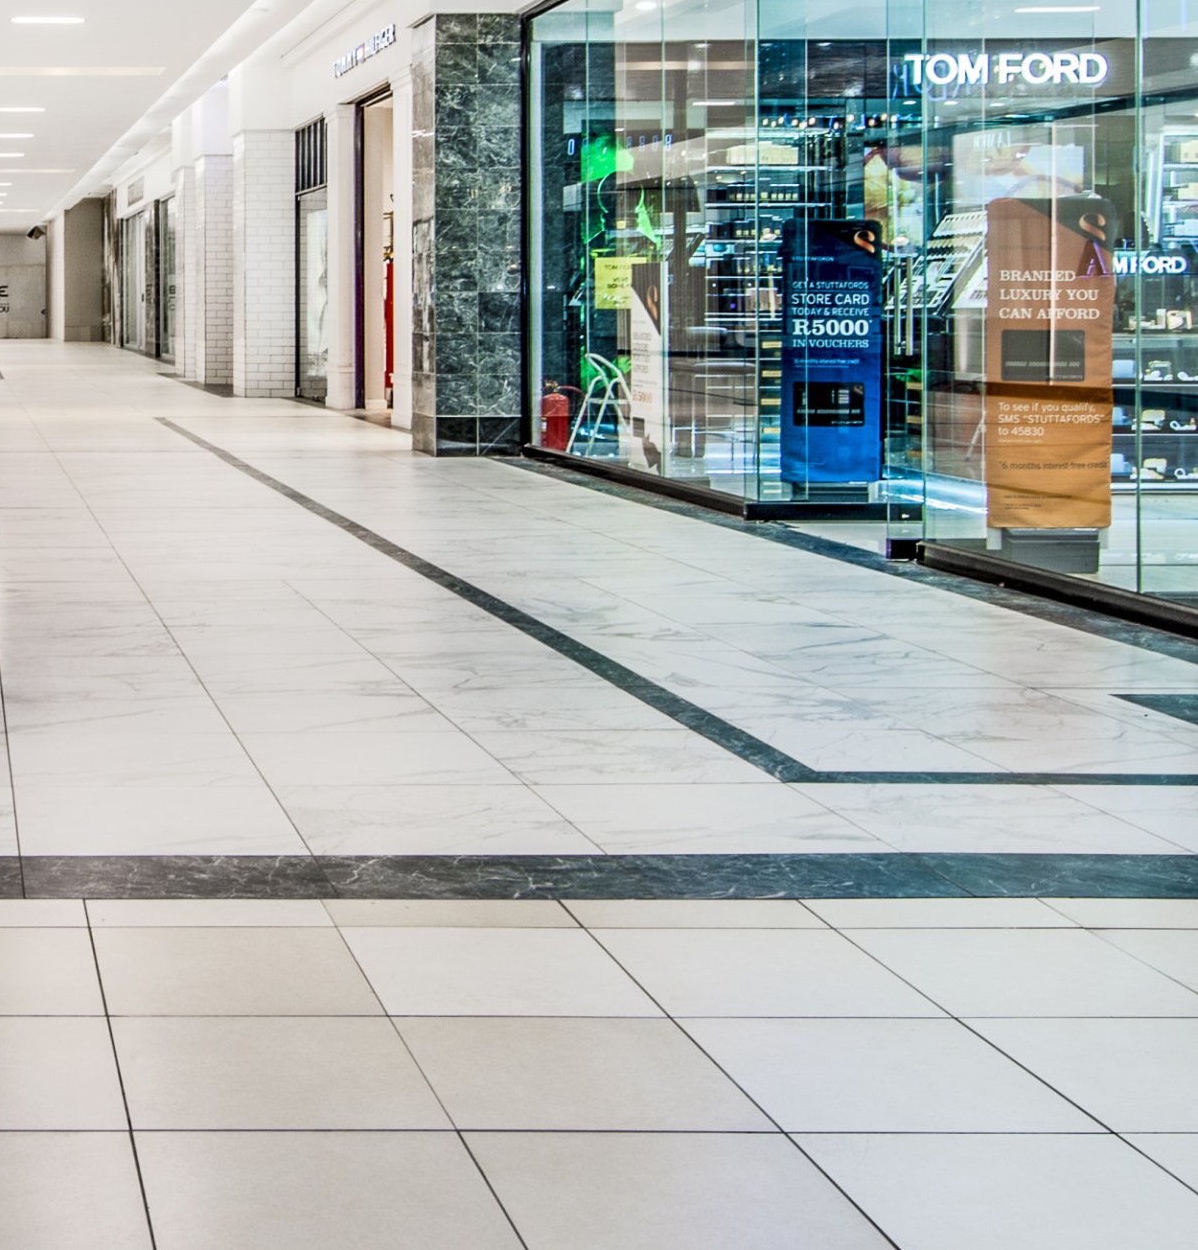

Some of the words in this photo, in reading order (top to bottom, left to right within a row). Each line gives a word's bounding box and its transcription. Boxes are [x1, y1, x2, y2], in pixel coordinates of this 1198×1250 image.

[904, 53, 989, 85] TOM
[999, 53, 1108, 85] FORD
[999, 270, 1076, 282] BRANDED
[816, 281, 869, 289] STUTTAFORDS
[791, 293, 832, 305] STORE
[835, 293, 870, 305] CARD
[999, 289, 1062, 301] LUXURY
[1066, 289, 1099, 301] YOU
[792, 307, 821, 316] TODAY
[823, 307, 830, 316] &
[832, 307, 869, 316] RECEIVE
[998, 308, 1033, 319] CAN
[792, 339, 806, 348] IN
[809, 339, 869, 348] VOUCHERS
[998, 402, 1010, 412] To
[1012, 404, 1029, 412] see
[1031, 402, 1038, 412] if
[1041, 404, 1059, 413] you
[998, 415, 1020, 424] SMS
[998, 427, 1008, 436] to
[1011, 427, 1045, 436] 45830
